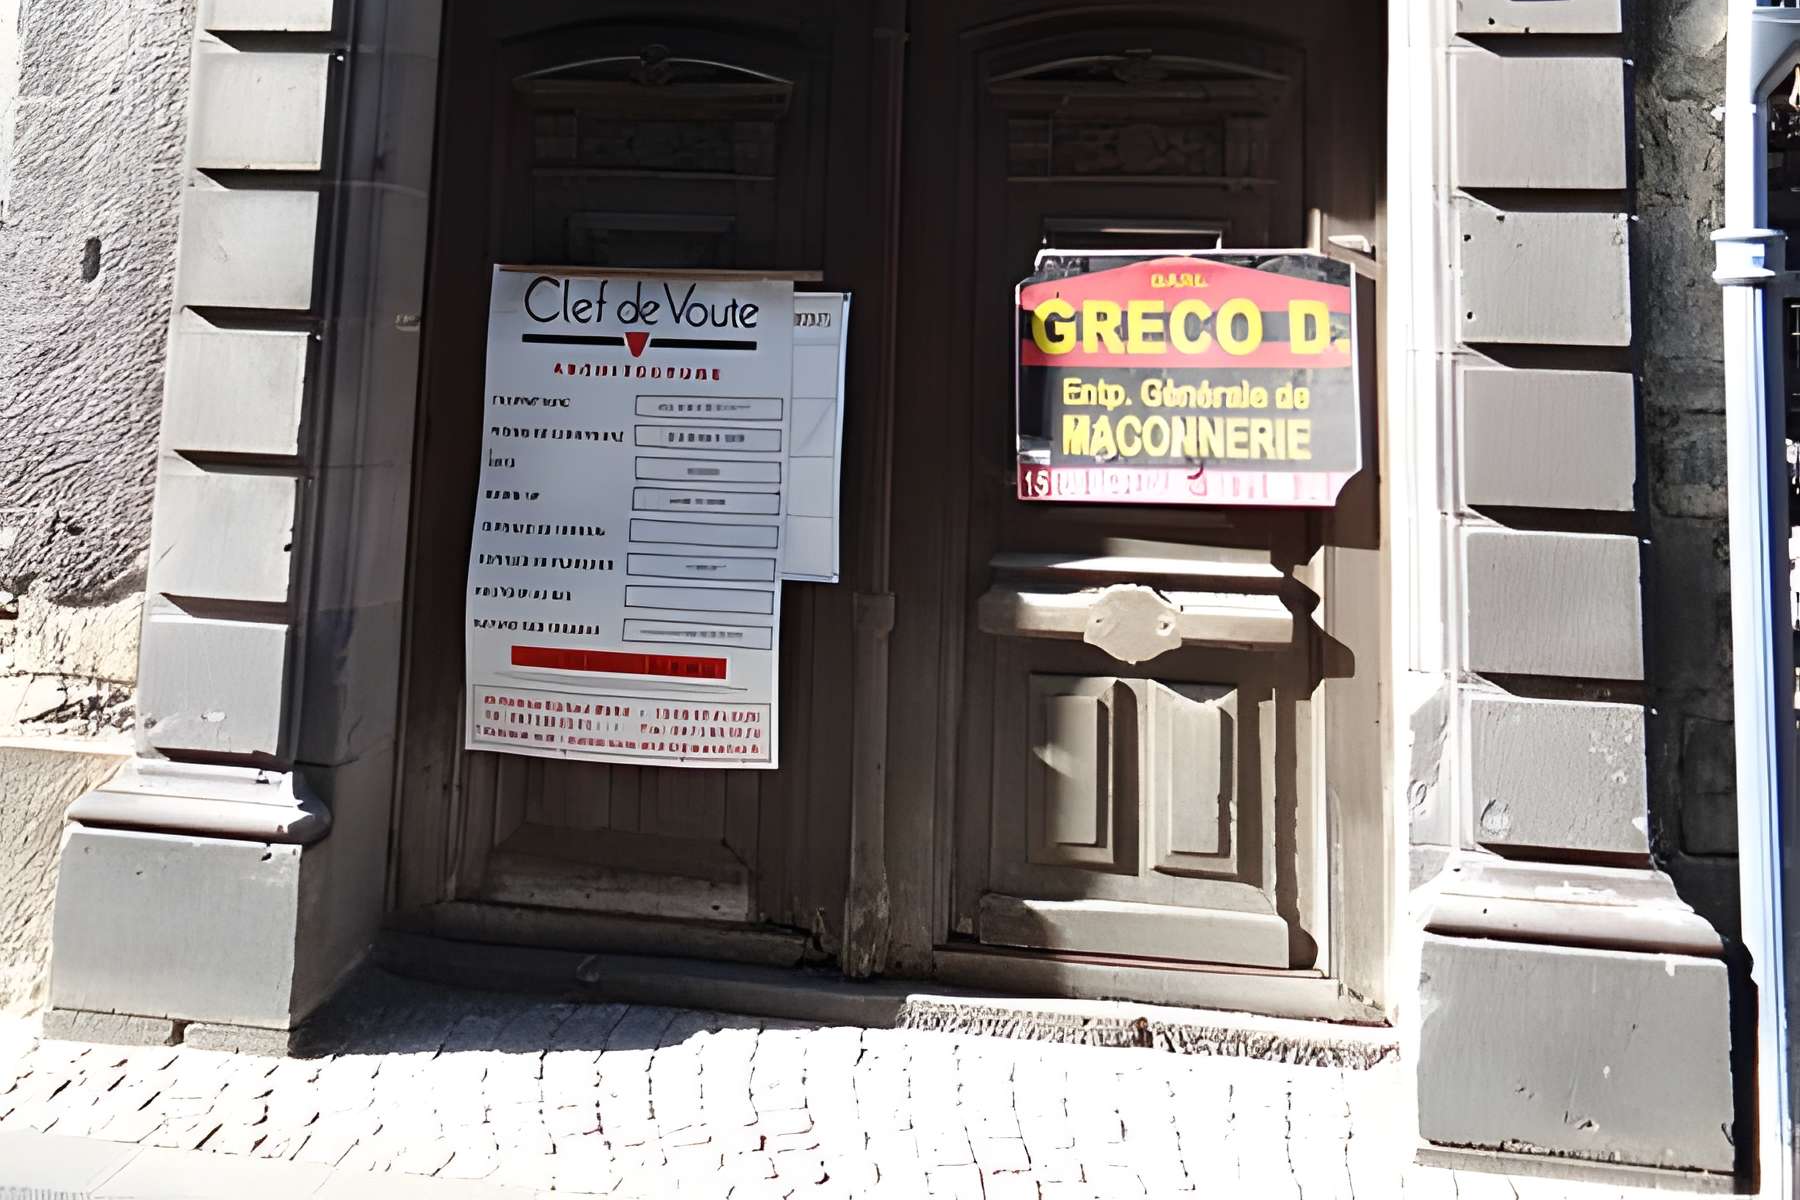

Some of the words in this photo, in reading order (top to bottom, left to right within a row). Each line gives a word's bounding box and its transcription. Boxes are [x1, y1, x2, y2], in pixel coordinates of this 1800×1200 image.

[524, 275, 609, 324] Clef
[616, 280, 661, 326] de
[663, 282, 760, 329] Voute
[1031, 297, 1264, 356] GRECO
[1275, 381, 1311, 410] de
